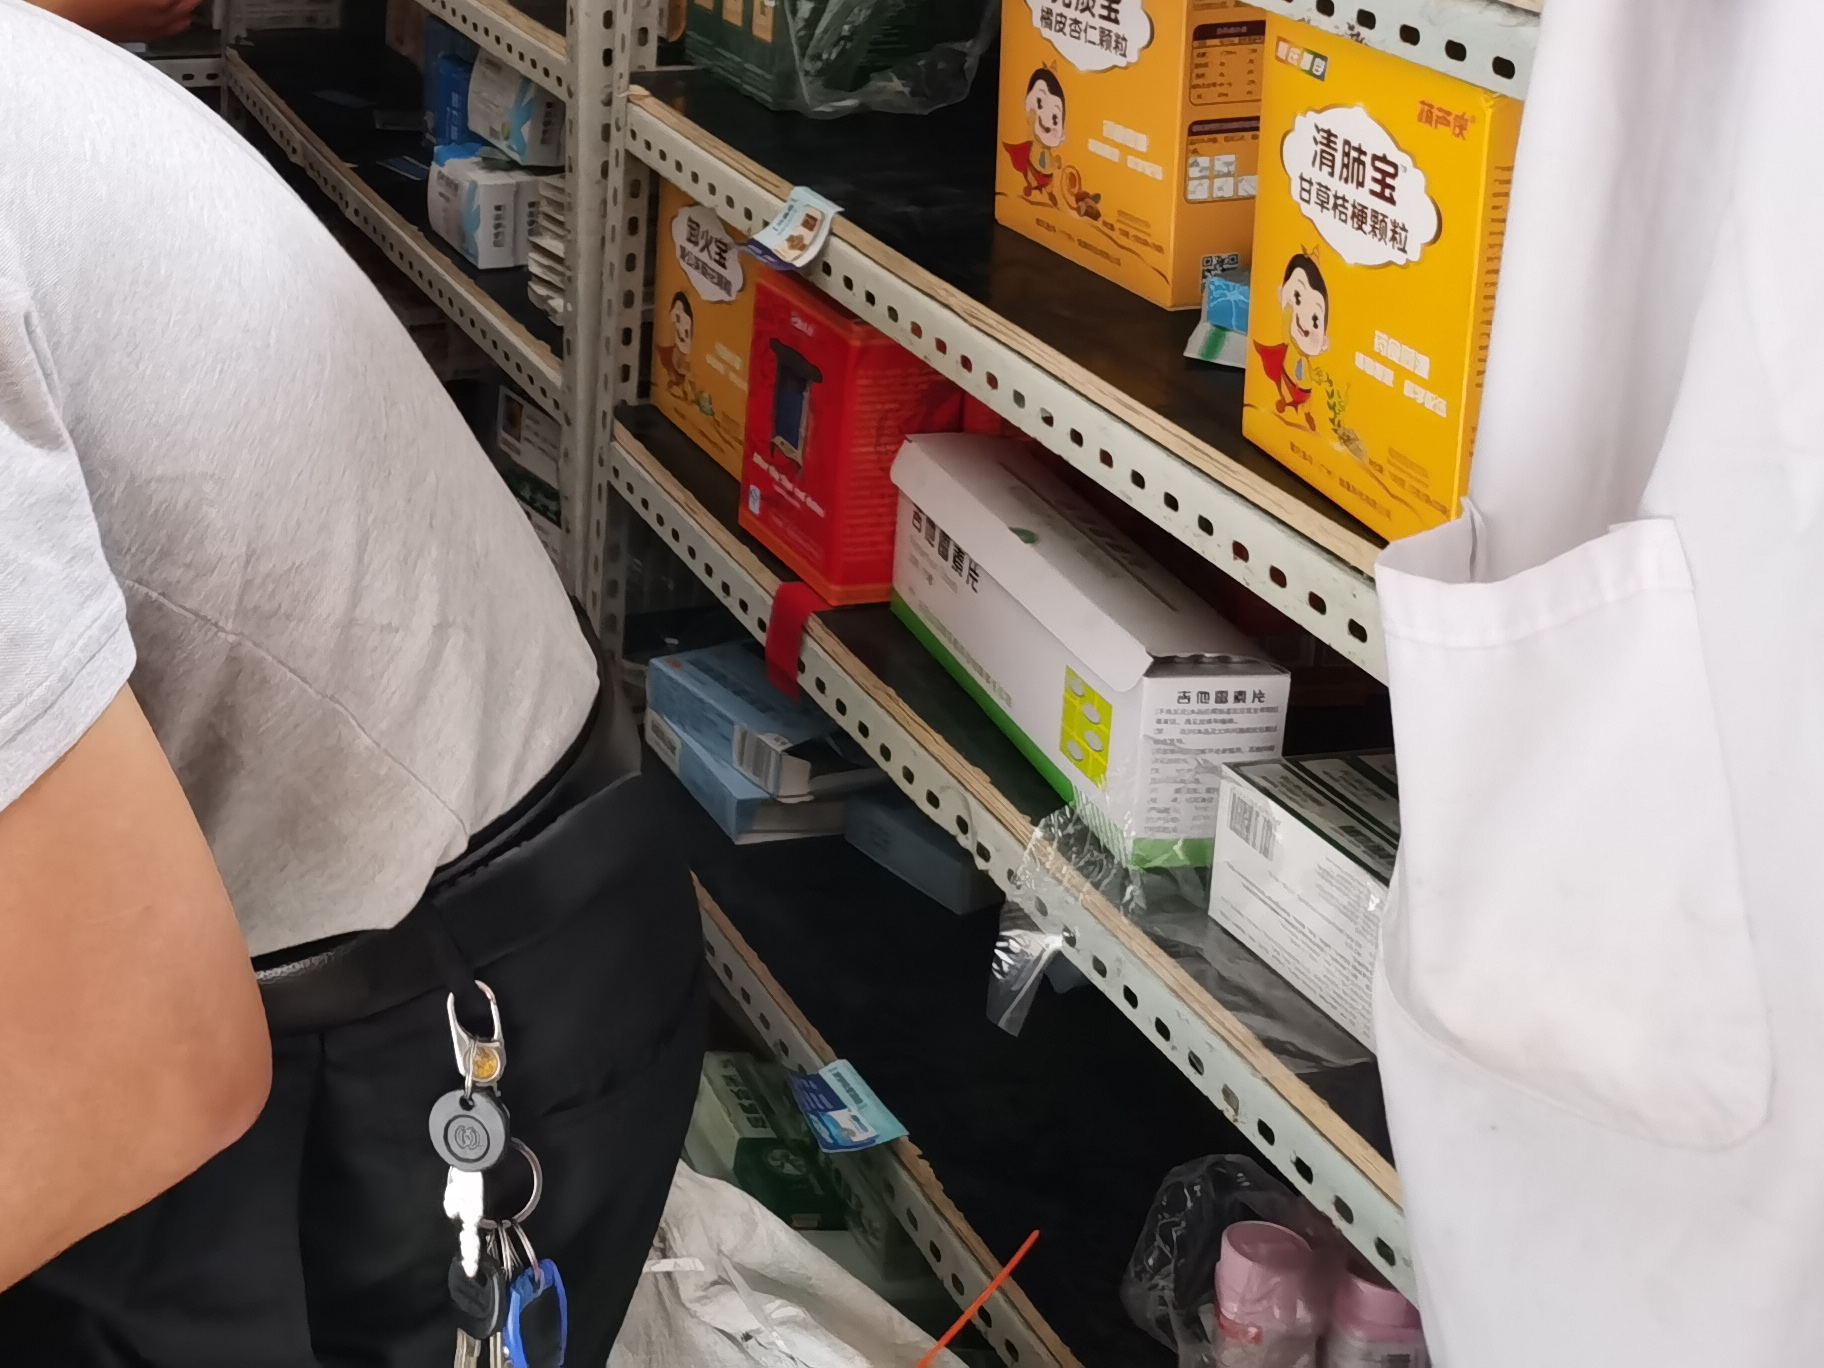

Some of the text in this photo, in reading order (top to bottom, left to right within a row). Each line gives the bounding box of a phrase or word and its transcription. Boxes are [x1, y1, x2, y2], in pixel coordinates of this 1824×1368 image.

[1040, 5, 1128, 58] 橘皮杏仁颗粒
[1312, 123, 1400, 206] 清肺宝
[1299, 172, 1409, 254] 甘草桔梗颗粒
